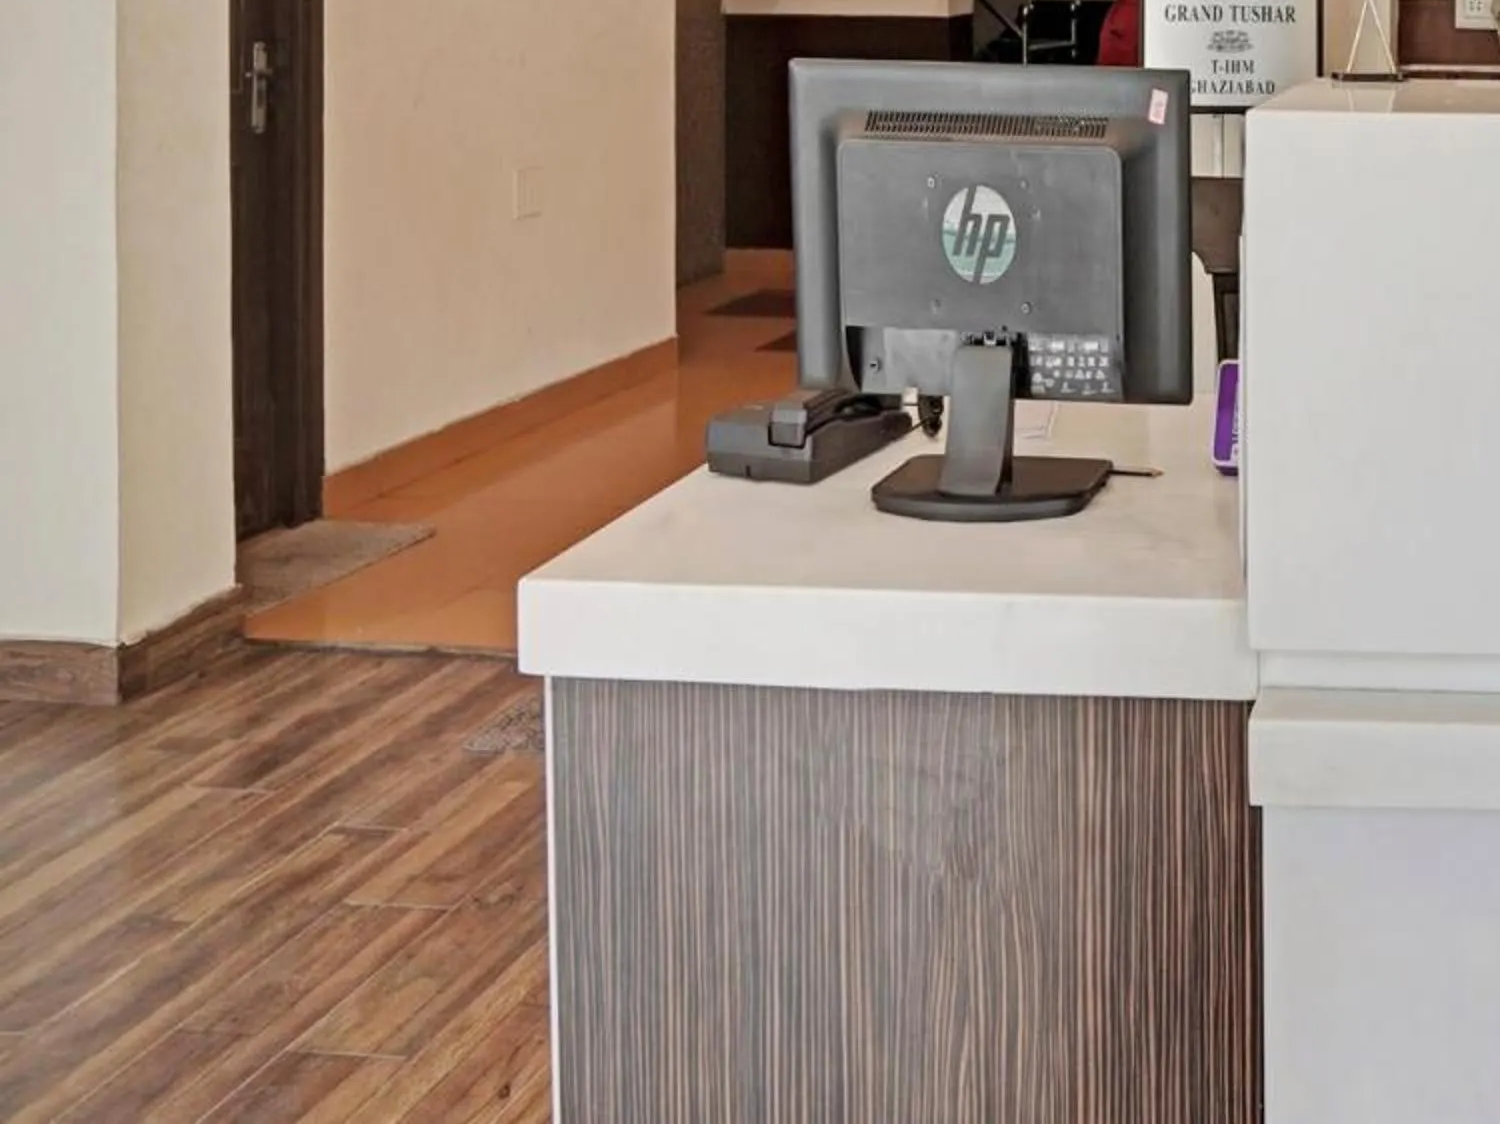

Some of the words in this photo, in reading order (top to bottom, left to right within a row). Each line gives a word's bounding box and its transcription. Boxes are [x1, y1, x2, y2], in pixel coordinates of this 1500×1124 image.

[1164, 4, 1223, 23] GRAND
[1229, 4, 1296, 23] TUSHAR
[951, 185, 1011, 284] hp
